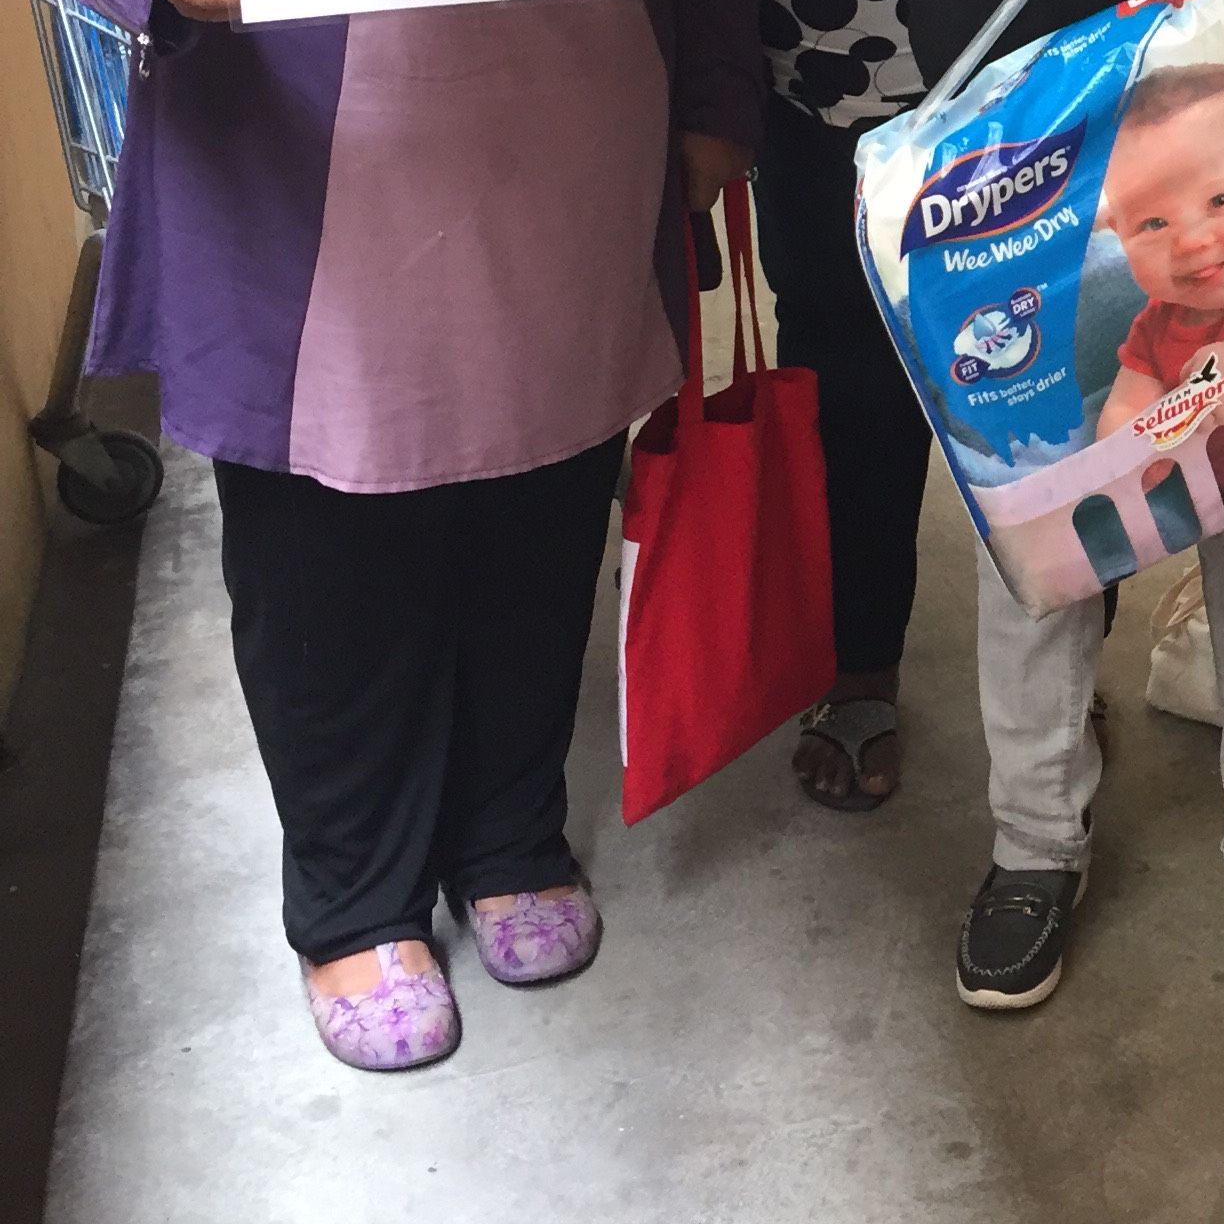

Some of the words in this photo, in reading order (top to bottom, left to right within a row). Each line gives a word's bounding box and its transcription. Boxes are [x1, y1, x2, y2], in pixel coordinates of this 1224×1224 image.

[921, 148, 1069, 238] Drypers
[1012, 297, 1035, 315] DRY
[961, 361, 978, 377] FIT
[1000, 378, 1035, 398] better,
[1036, 367, 1067, 392] drier
[967, 390, 999, 406] Fits
[1008, 389, 1035, 406] stays
[1160, 388, 1191, 408] TEAM
